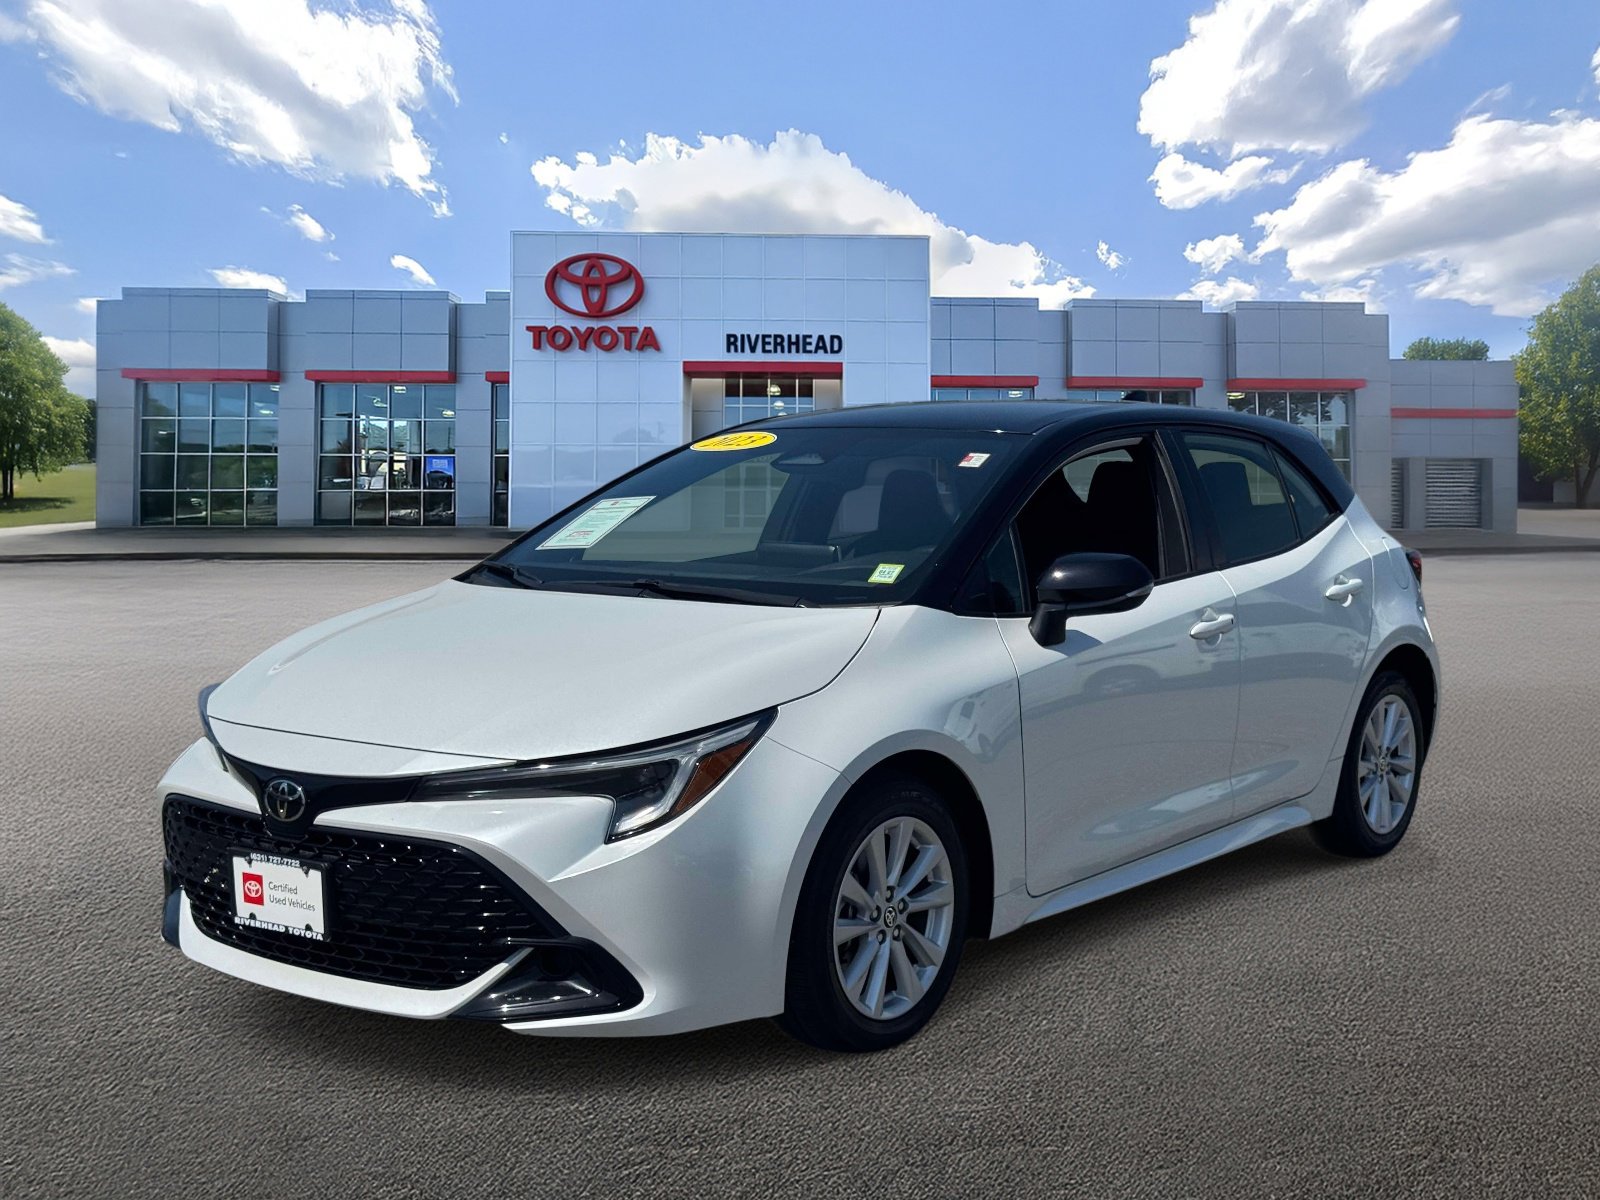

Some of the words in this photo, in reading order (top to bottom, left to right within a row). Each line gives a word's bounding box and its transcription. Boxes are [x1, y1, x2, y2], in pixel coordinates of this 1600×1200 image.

[526, 326, 661, 352] TOYOTA
[726, 333, 844, 354] RIVERHEAD
[250, 852, 267, 860] (631)
[268, 882, 298, 894] Certified
[269, 895, 286, 906] Used
[287, 898, 316, 912] Vehicles
[234, 917, 286, 932] RIVERHEAD
[287, 926, 323, 940] TOYOTA
